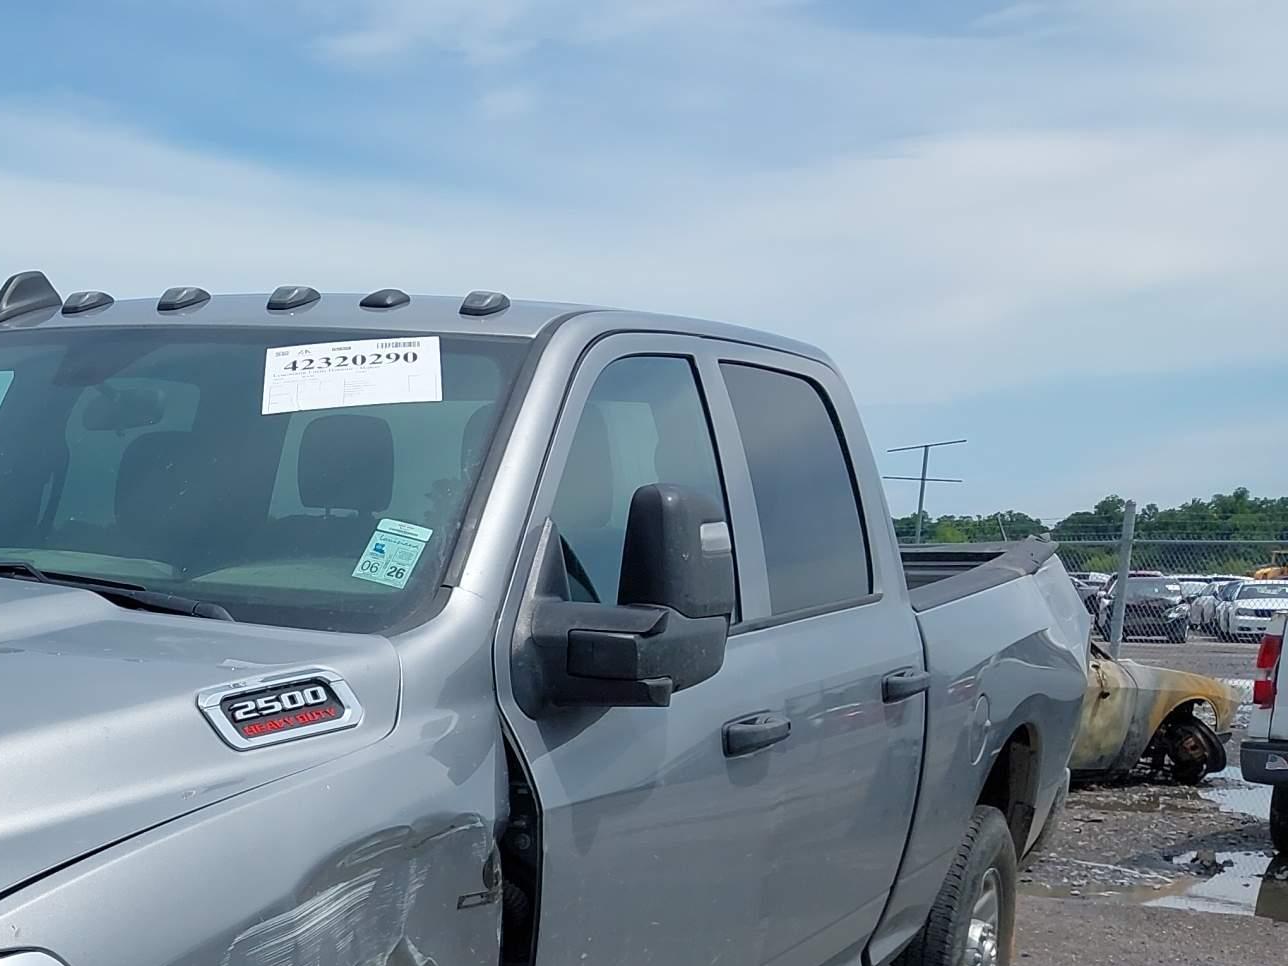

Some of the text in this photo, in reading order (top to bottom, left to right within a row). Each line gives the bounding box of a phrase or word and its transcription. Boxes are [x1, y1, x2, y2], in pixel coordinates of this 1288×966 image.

[283, 351, 418, 372] 42320290
[361, 560, 406, 579] 06 26
[231, 687, 327, 720] 2500
[243, 708, 337, 735] HEAVY DUTY
